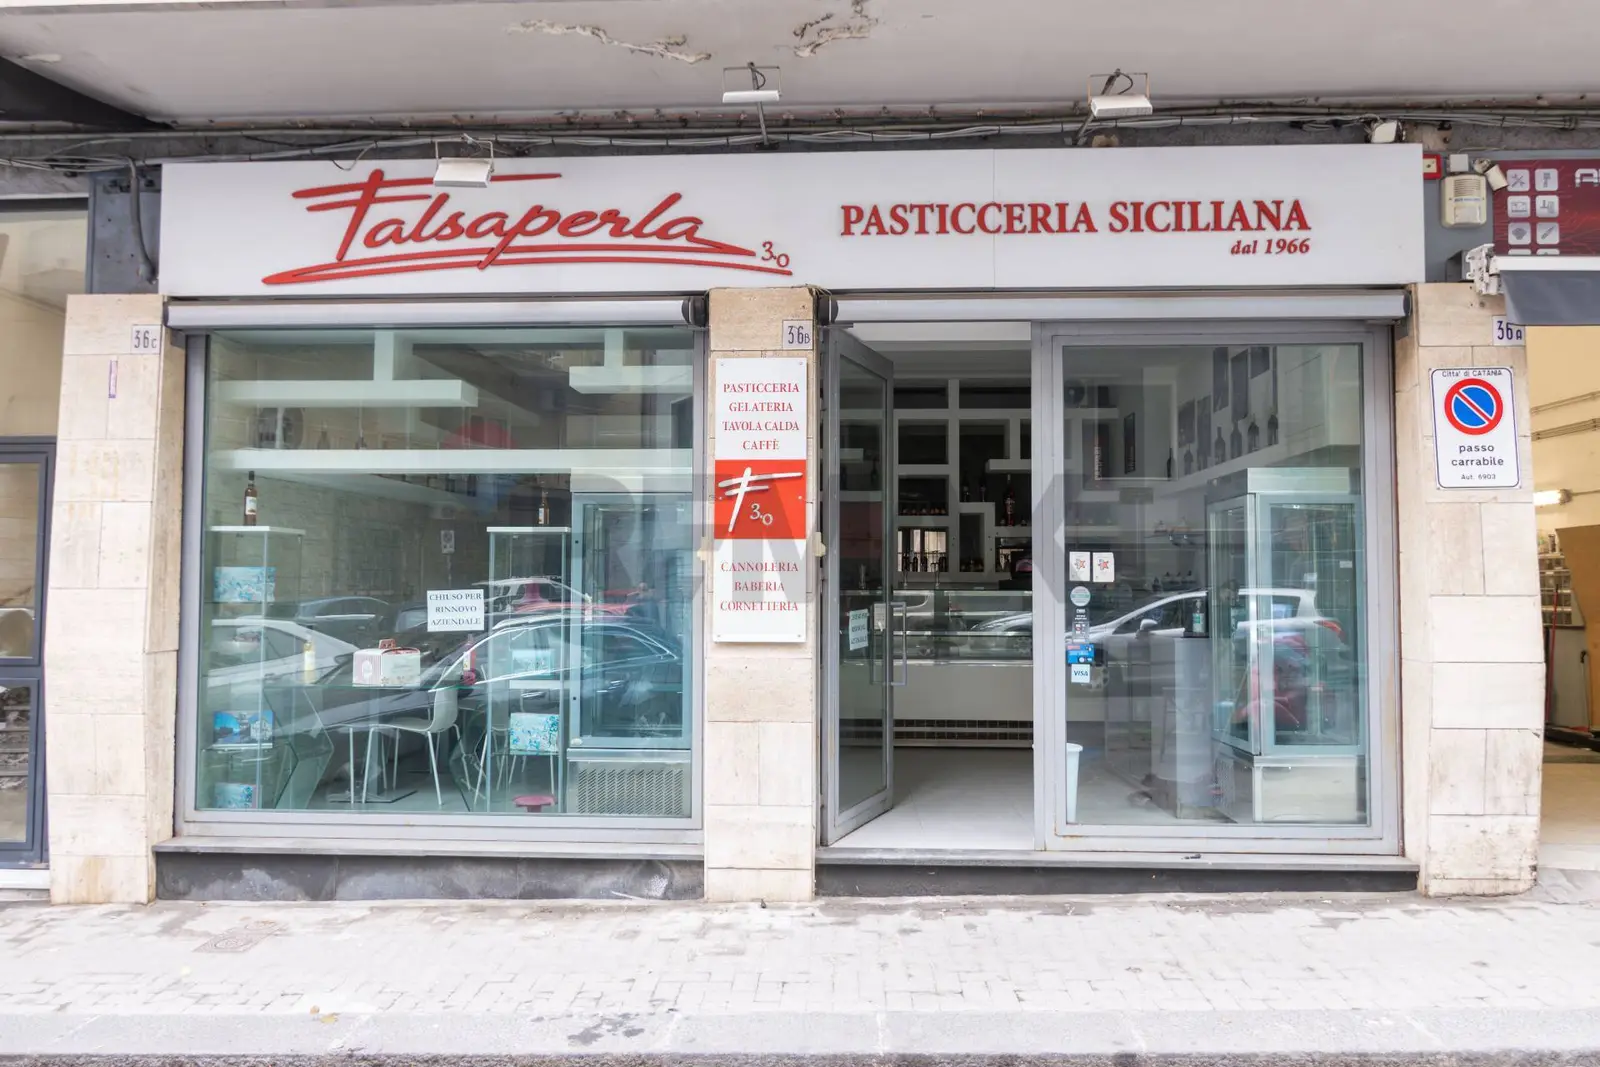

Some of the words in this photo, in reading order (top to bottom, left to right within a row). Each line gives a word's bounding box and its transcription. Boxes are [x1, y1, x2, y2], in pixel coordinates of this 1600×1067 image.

[285, 167, 758, 275] Falsaperla
[840, 202, 1099, 236] PASTICCERIA
[1108, 199, 1312, 233] SICILIANA
[1230, 240, 1258, 256] dal
[1264, 238, 1311, 255] 1966
[1472, 369, 1503, 377] CATANIA
[723, 383, 800, 393] PASTICCERIA
[728, 402, 794, 412] GELATERIA
[722, 421, 762, 431] TAVOLA
[764, 421, 800, 431] CALDA
[742, 438, 780, 450] CAFFÈ
[1458, 444, 1495, 455] passo
[1451, 456, 1505, 467] carrabile
[720, 561, 799, 572] CANNOLERIA
[734, 581, 785, 592] BABERIA
[429, 593, 463, 601] CHIUSO
[464, 592, 482, 600] PER
[435, 605, 477, 613] RINNOVO
[720, 600, 799, 611] CORNETTERIA
[430, 617, 482, 626] AZIENDALE
